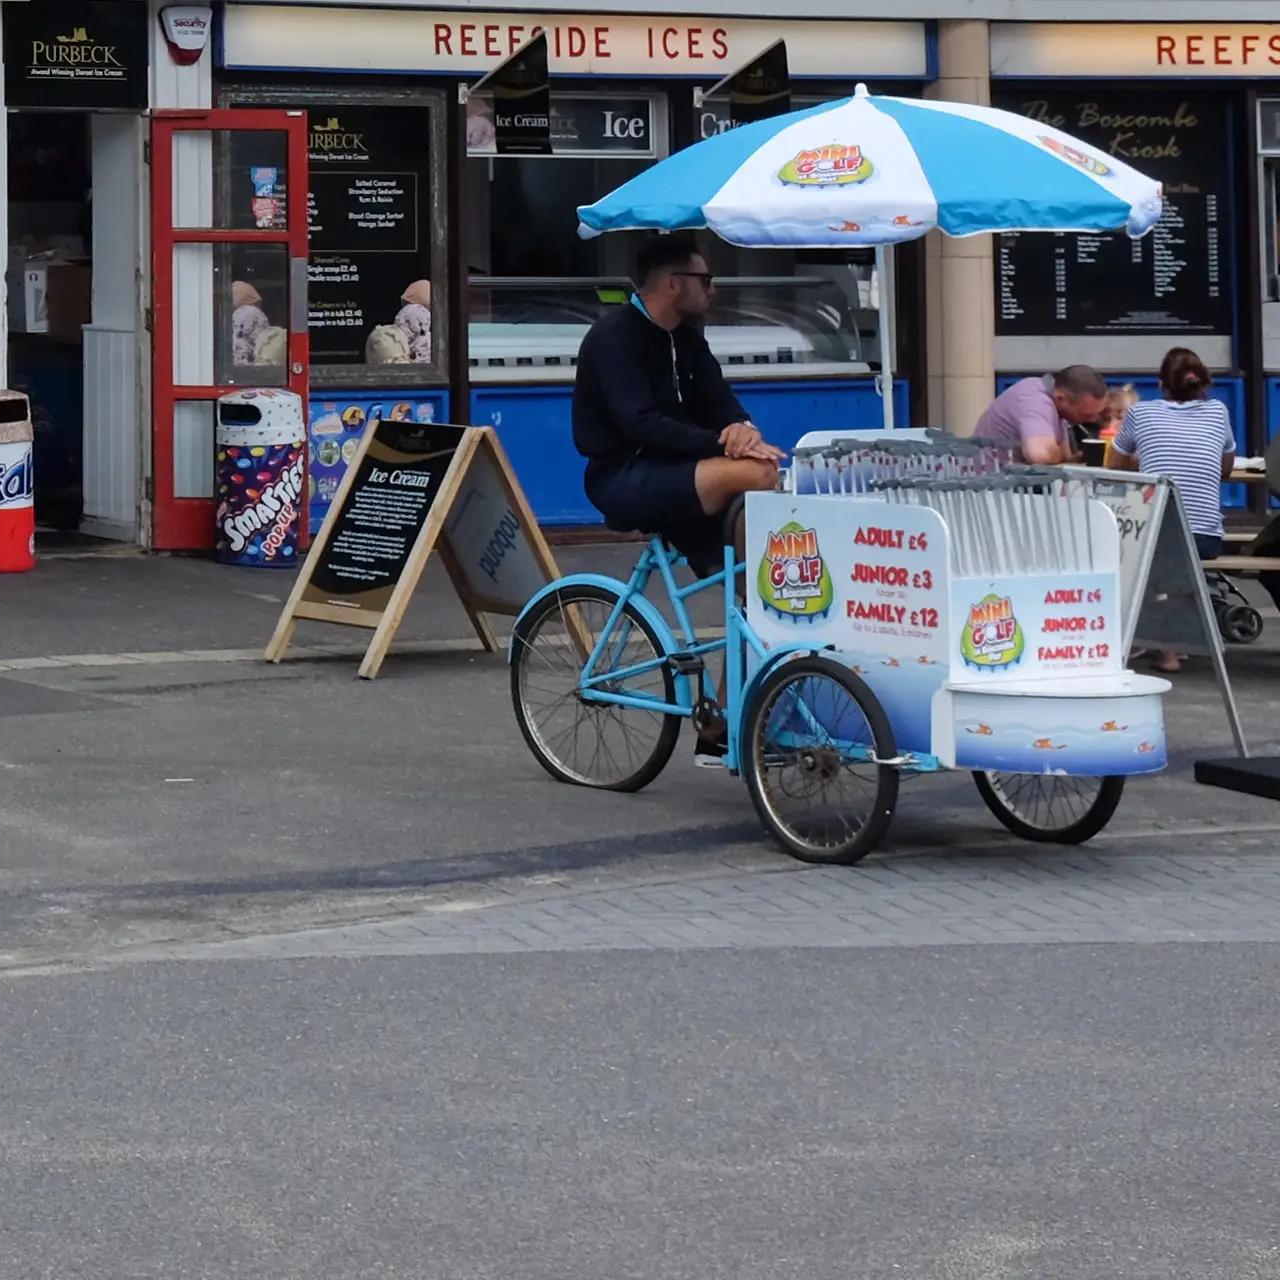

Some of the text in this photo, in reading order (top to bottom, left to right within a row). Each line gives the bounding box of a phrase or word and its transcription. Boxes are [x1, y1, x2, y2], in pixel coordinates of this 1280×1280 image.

[31, 40, 124, 67] PURBECK
[433, 23, 729, 59] REEFIDE ICES
[496, 114, 511, 127] Ice
[514, 114, 548, 128] Cream
[602, 110, 645, 139] Ice
[1075, 102, 1200, 129] Boscombe
[795, 144, 861, 164] MINI
[1108, 131, 1183, 159] Kiosk
[794, 156, 864, 175] GOLF
[368, 467, 430, 488] Ice Cream
[260, 503, 293, 556] POP UP
[853, 525, 929, 553] ADULT £4
[766, 527, 820, 563] MINI
[769, 555, 824, 590] GOLF
[850, 562, 934, 591] JUNIOR £3
[1044, 588, 1084, 605] ADULT
[845, 599, 941, 629] FAMILY £12
[968, 596, 1014, 627] MINI
[1040, 615, 1106, 633] JUNIOR £3
[971, 617, 1017, 649] GOLF
[1037, 643, 1110, 661] FAMILY £12
